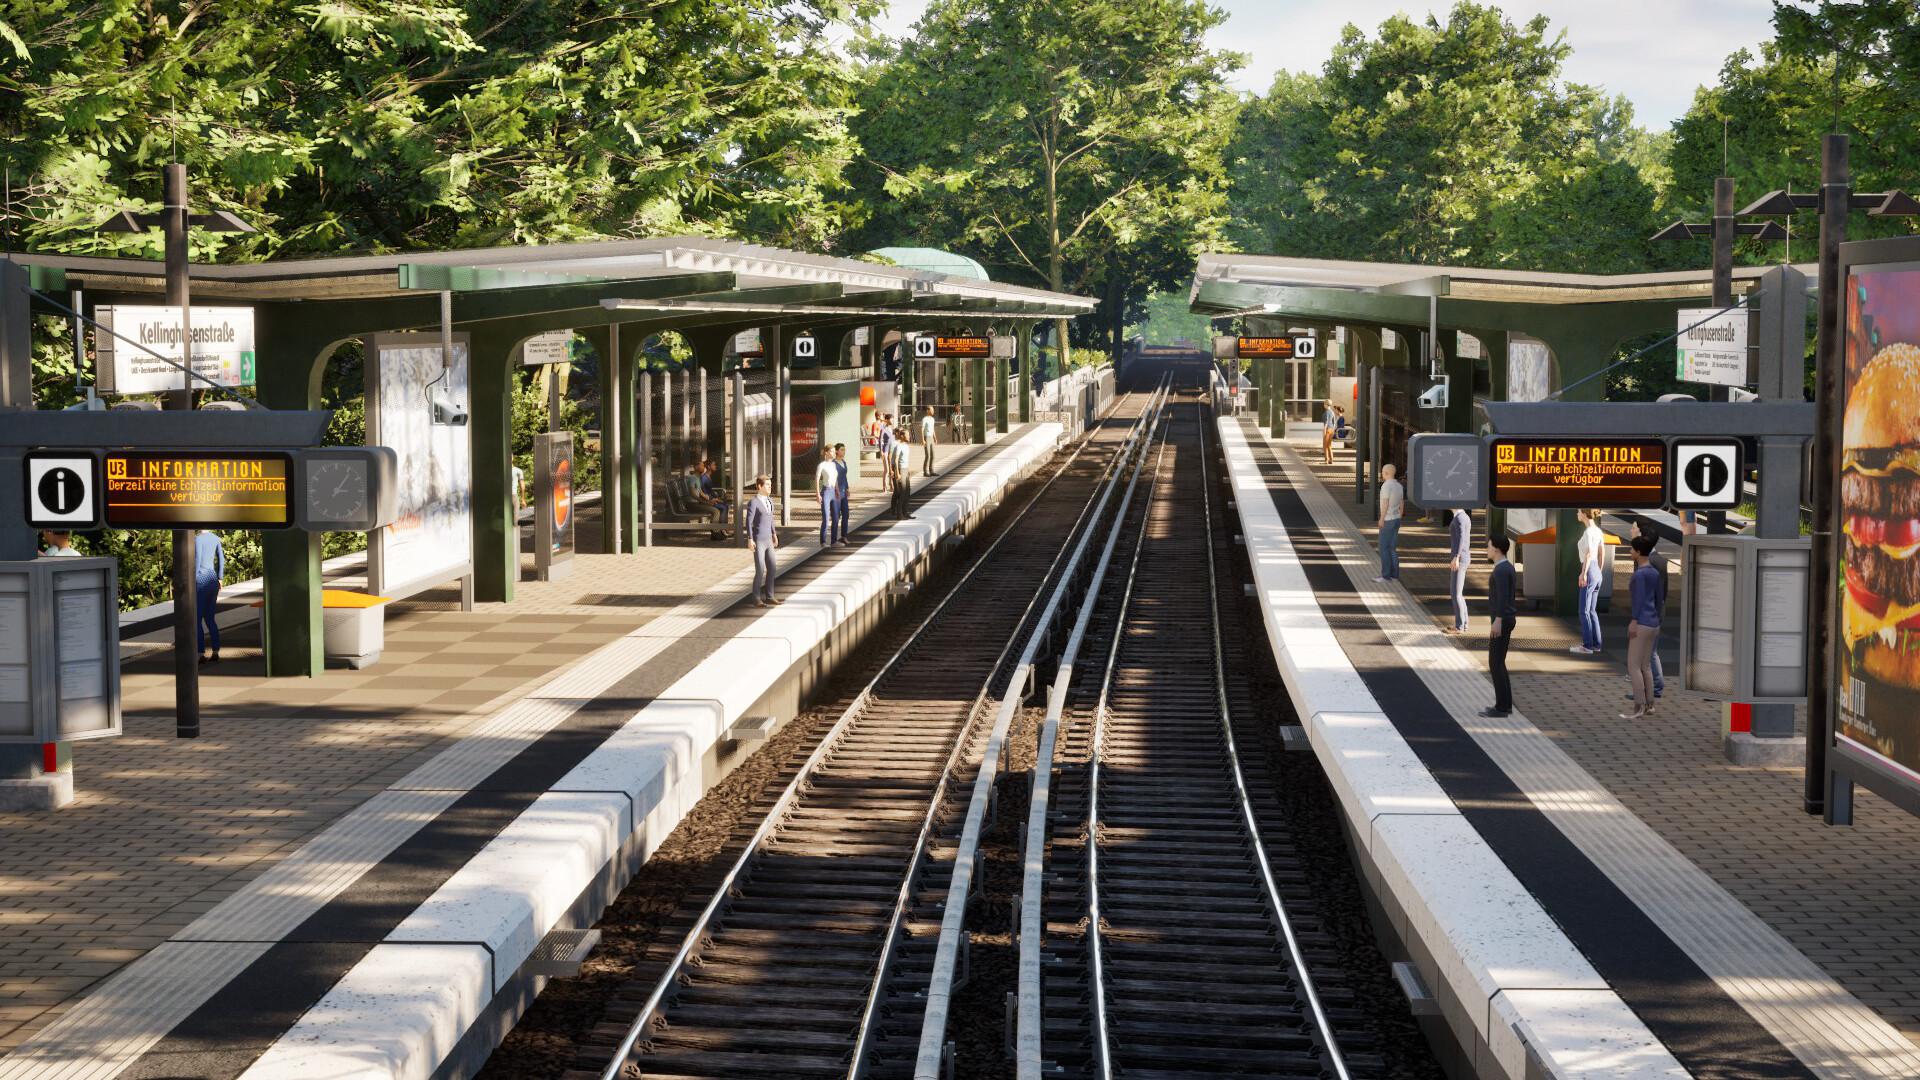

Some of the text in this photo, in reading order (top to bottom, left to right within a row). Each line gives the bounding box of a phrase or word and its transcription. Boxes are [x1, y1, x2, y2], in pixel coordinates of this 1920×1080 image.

[1499, 447, 1641, 462] U3 INFORMATION
[110, 461, 262, 477] U3 INFORMATION
[1497, 464, 1662, 474] Derzeit keine Echtzeitinformation
[108, 480, 285, 490] Derzeit keine Echtzeitinformation
[1554, 474, 1604, 485] verfügbar
[170, 492, 224, 504] verfügbar
